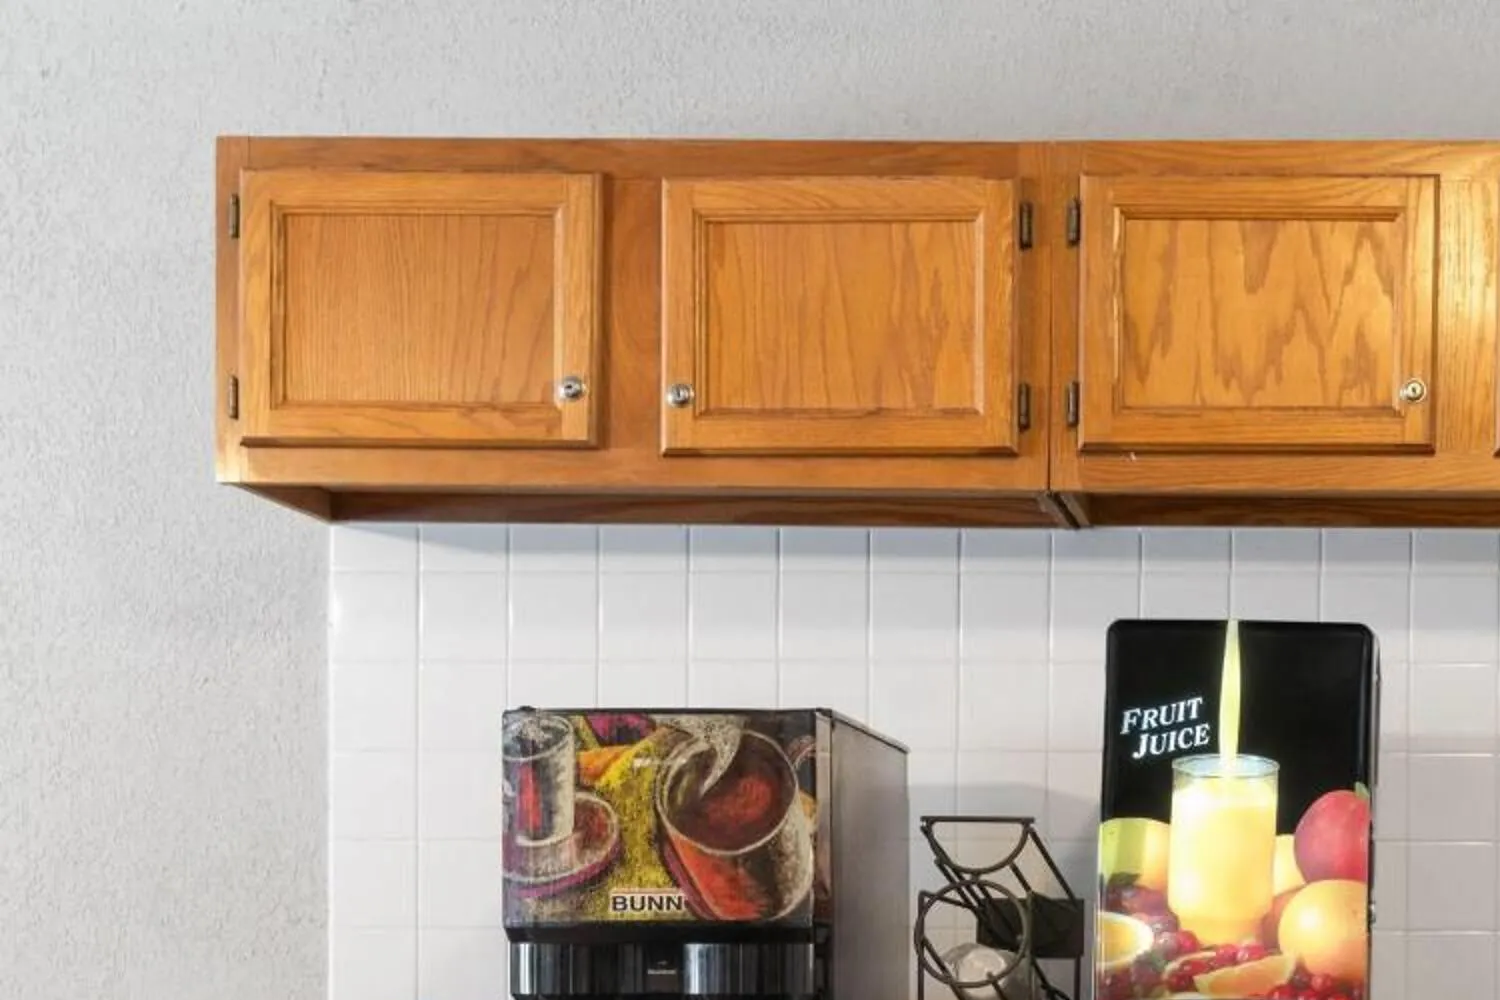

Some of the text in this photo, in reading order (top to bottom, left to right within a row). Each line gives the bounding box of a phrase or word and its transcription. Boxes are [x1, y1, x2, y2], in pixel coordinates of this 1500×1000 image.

[1120, 696, 1203, 735] FRUIT
[1132, 722, 1210, 759] JUICE
[612, 895, 683, 912] BUNN
